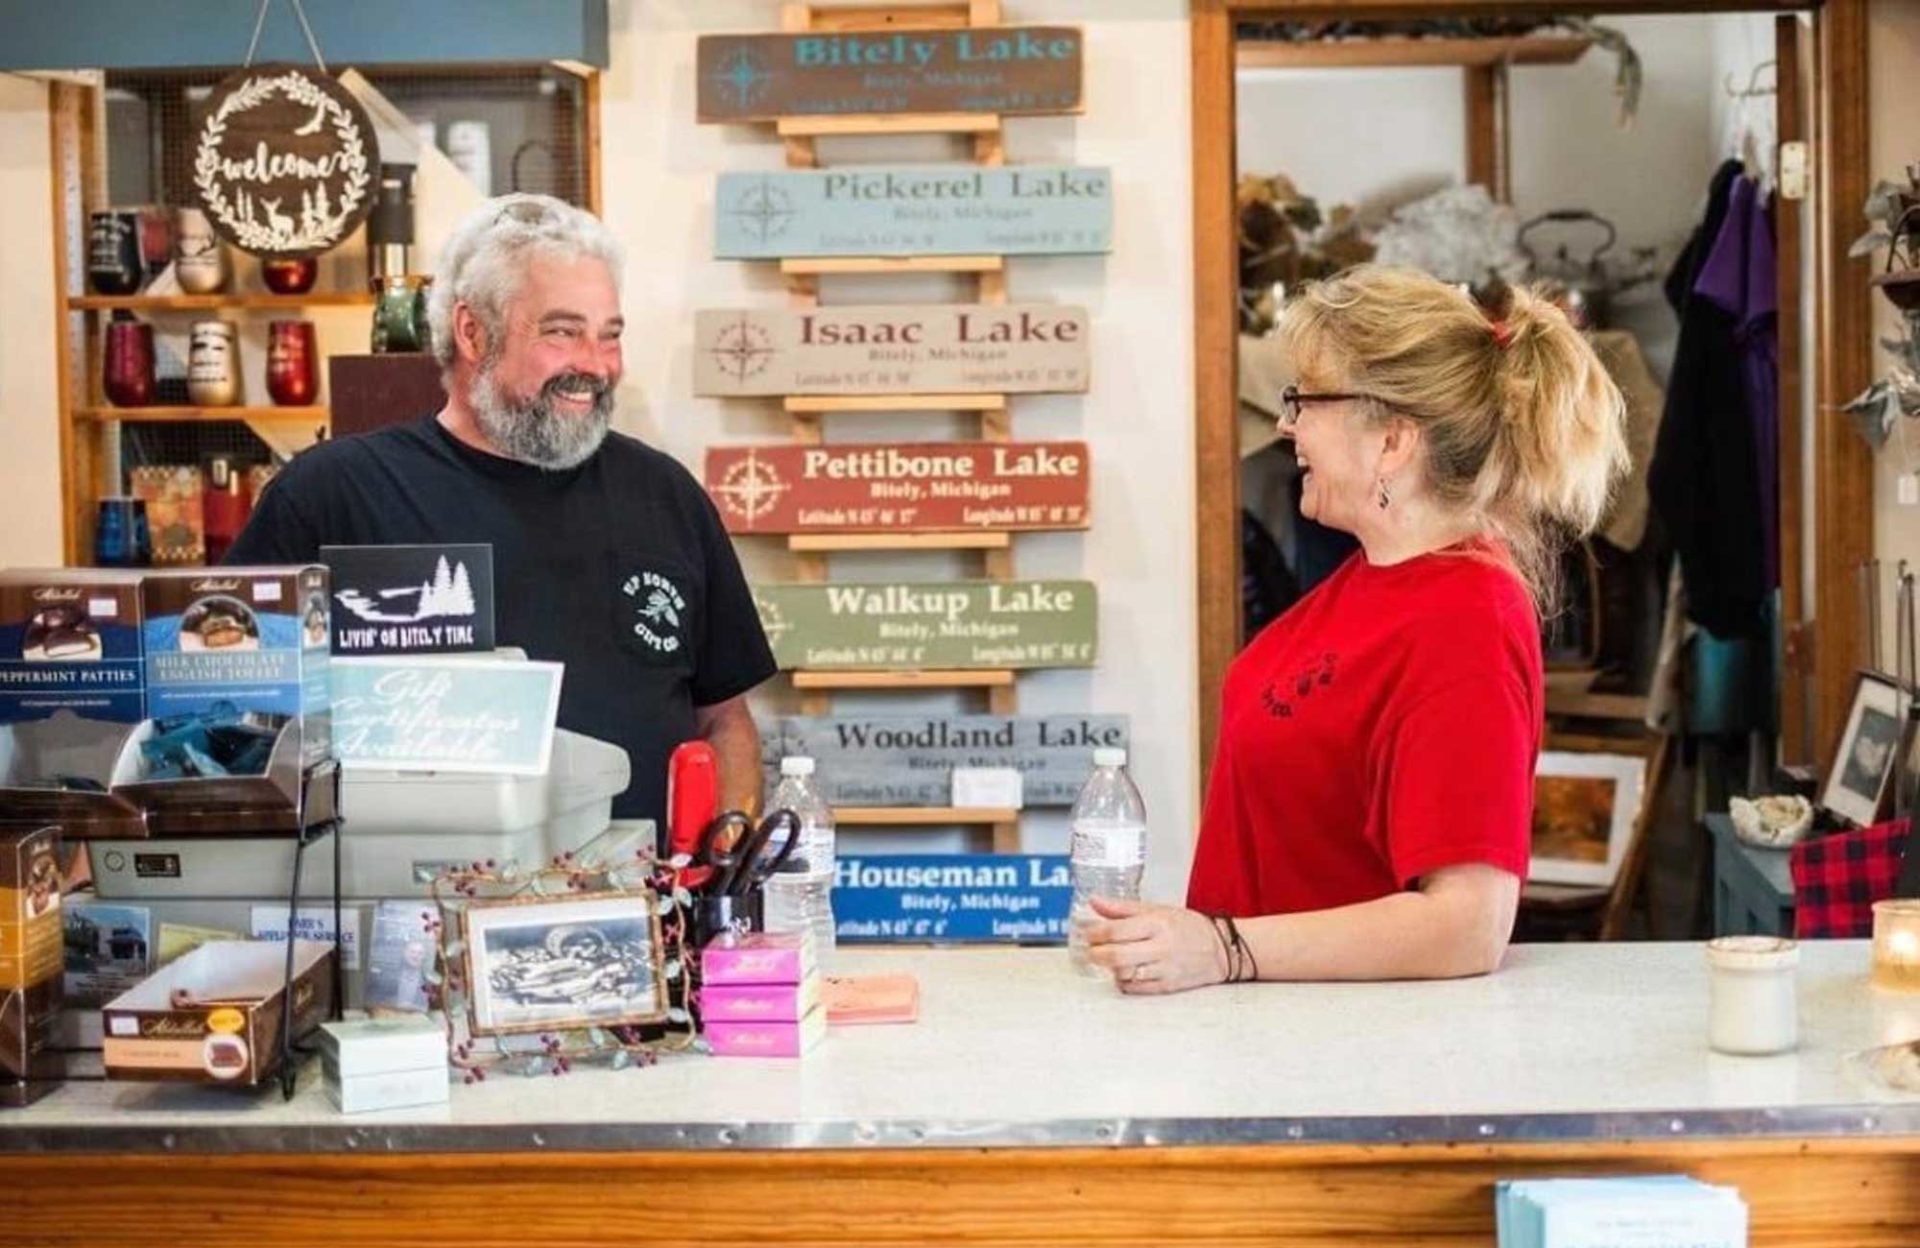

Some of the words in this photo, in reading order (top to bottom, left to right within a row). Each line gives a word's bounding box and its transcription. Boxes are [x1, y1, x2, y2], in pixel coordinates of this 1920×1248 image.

[794, 35, 935, 67] Bitely
[957, 31, 1076, 61] Lake
[219, 141, 348, 185] welcome
[823, 172, 983, 200] Pickerel
[1009, 170, 1106, 198] Lake
[800, 315, 924, 345] Isaac
[956, 311, 1080, 342] Lake
[803, 449, 975, 478] Pettibone
[993, 447, 1080, 476] Lake
[930, 481, 1012, 500] Michigan
[825, 586, 970, 621] Walkup
[988, 584, 1075, 613] Lake
[445, 624, 475, 646] TIME
[937, 620, 1019, 639] Michigan
[81, 669, 136, 682] PATTIES
[836, 722, 1015, 750] Woodland
[1037, 720, 1123, 748] Lake
[833, 860, 1019, 888] Houseman
[959, 894, 1041, 911] Michigan
